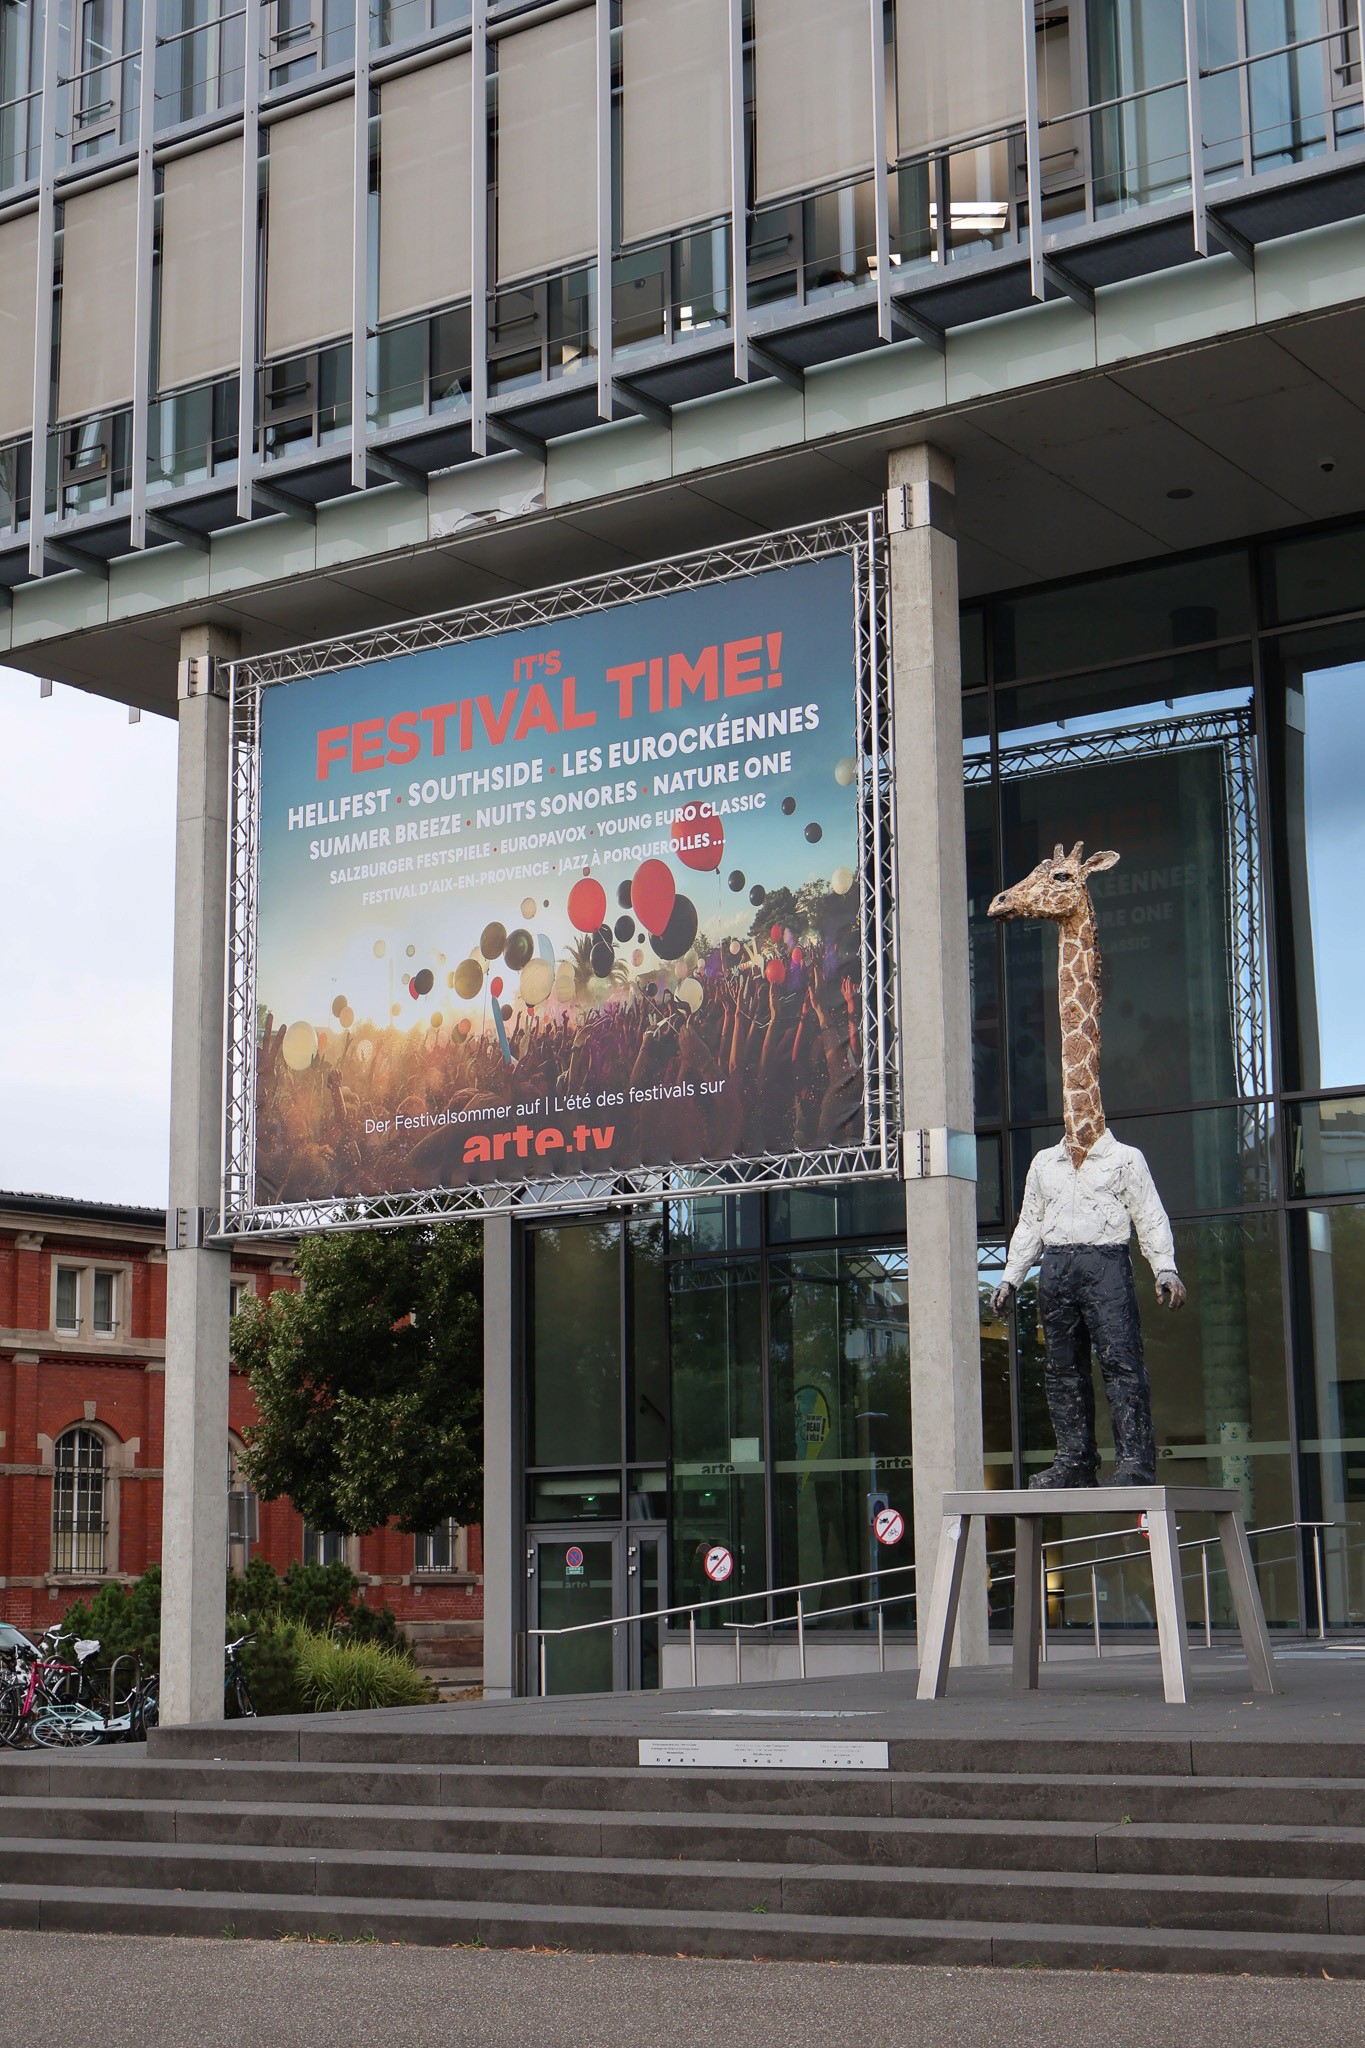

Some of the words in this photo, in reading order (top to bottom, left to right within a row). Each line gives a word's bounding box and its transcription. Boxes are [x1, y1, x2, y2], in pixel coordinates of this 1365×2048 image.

[513, 650, 562, 683] IT'S
[317, 676, 597, 782] FESTIVAL
[606, 631, 783, 720] TIME!
[288, 788, 392, 831] HELLFEST
[408, 759, 543, 807] SOUTHSIDE
[562, 746, 602, 778] LES
[608, 703, 820, 769] EUROCKÉENNES
[309, 827, 391, 860] SUMMER
[395, 813, 461, 844] BREEZE
[476, 800, 536, 829] NUITS
[540, 780, 637, 819] SONORES
[653, 761, 739, 796] NATURE
[744, 750, 792, 778] ONE
[329, 856, 413, 885] SALZBURGER
[416, 842, 490, 869] FESTSPIELE
[500, 825, 587, 854] EUROPAVOX
[596, 813, 652, 838] YOUNG
[655, 805, 697, 828] EURO
[699, 792, 766, 819] CLASSIC
[362, 881, 417, 906] FESTIVAL
[419, 860, 549, 896] D'AIX-EN-PROVENCE
[558, 855, 589, 876] JAZZ
[590, 848, 601, 867] À
[603, 832, 710, 865] PORQUEROLLES
[365, 1116, 390, 1135] Der
[394, 1104, 512, 1131] Festivalsommer
[516, 1098, 541, 1117] auf
[554, 1093, 592, 1113] L'été
[596, 1089, 624, 1108] des
[628, 1083, 695, 1104] festivals
[699, 1079, 726, 1096] sur
[462, 1124, 616, 1164] arte.tv
[701, 1463, 735, 1475] arte
[875, 1456, 912, 1470] arte
[564, 1580, 588, 1589] arte
